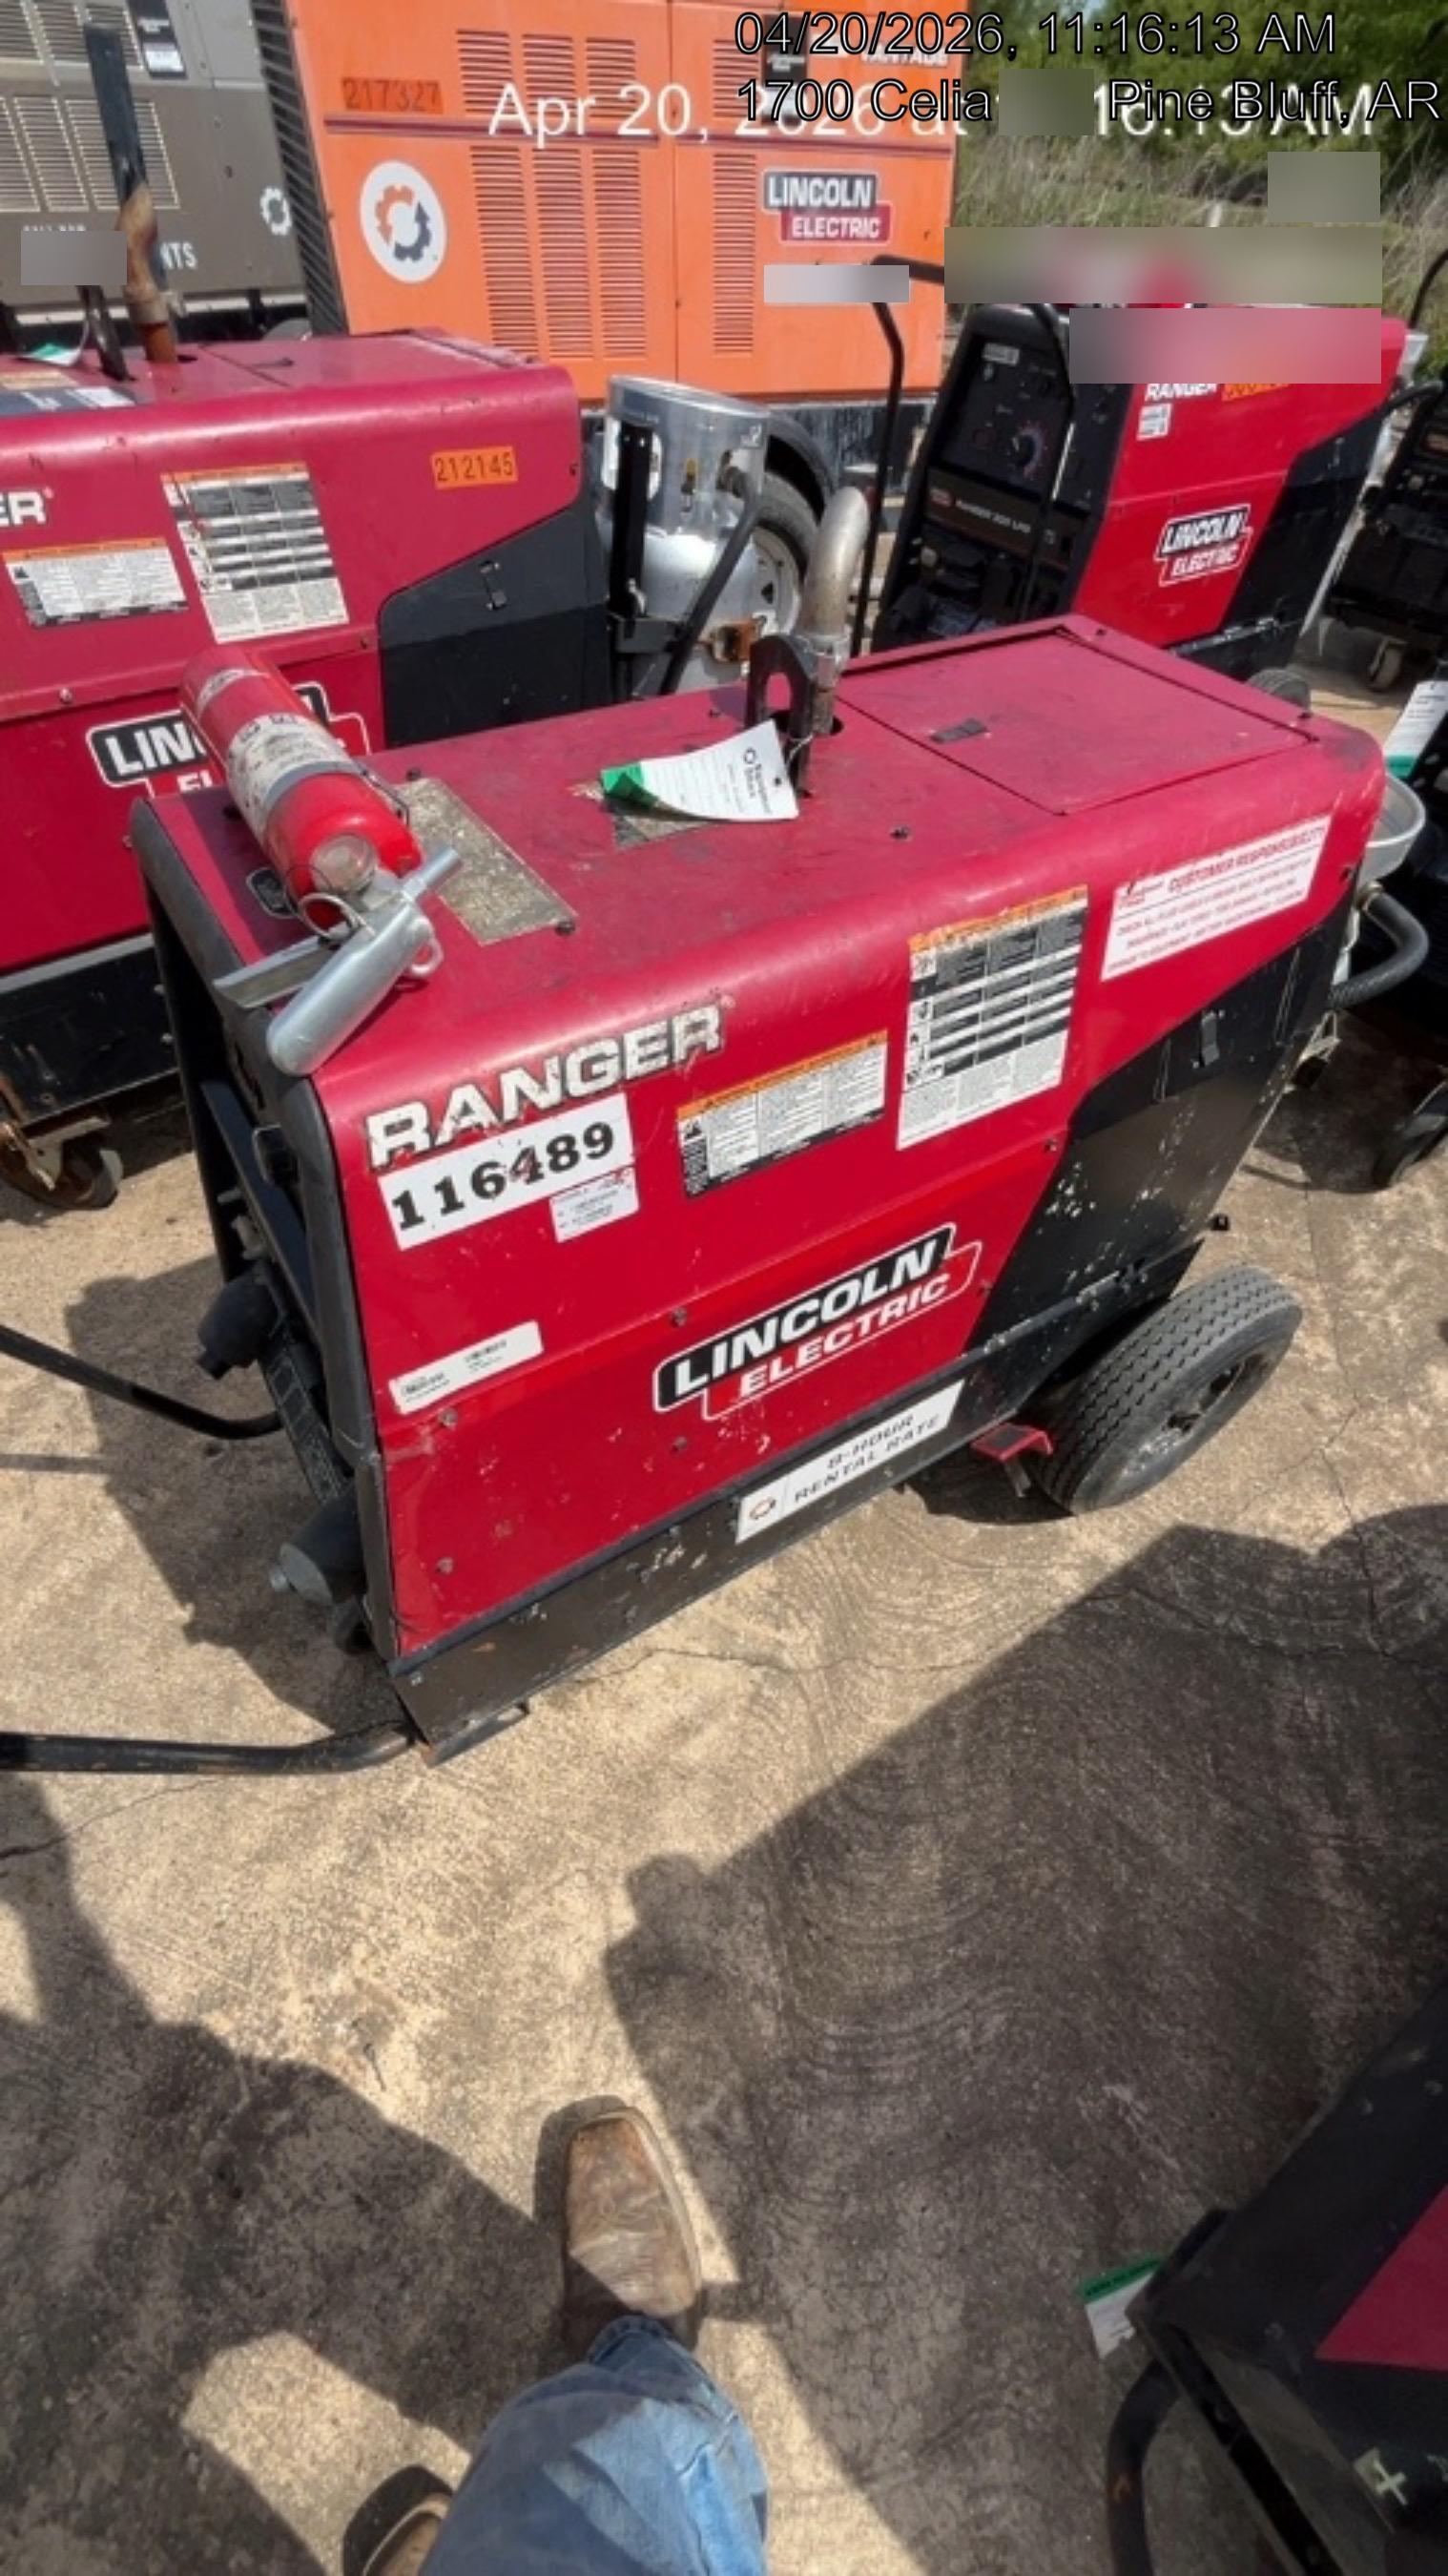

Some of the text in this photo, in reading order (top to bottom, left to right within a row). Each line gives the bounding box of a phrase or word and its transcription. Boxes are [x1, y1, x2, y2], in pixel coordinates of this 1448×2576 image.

[341, 77, 441, 113] 217327
[768, 176, 872, 208] LINCOLN
[791, 216, 881, 239] ELECTRIC
[434, 451, 513, 482] 212145
[1162, 511, 1244, 553] LINCOLN
[1170, 542, 1239, 577] ELECTRIC
[366, 1004, 721, 1168] RANGER
[391, 1121, 614, 1231] 116489
[675, 1239, 938, 1397] LINCOLN
[739, 1273, 951, 1399] ELECTRIC
[795, 1414, 940, 1504] RENTAL RATE
